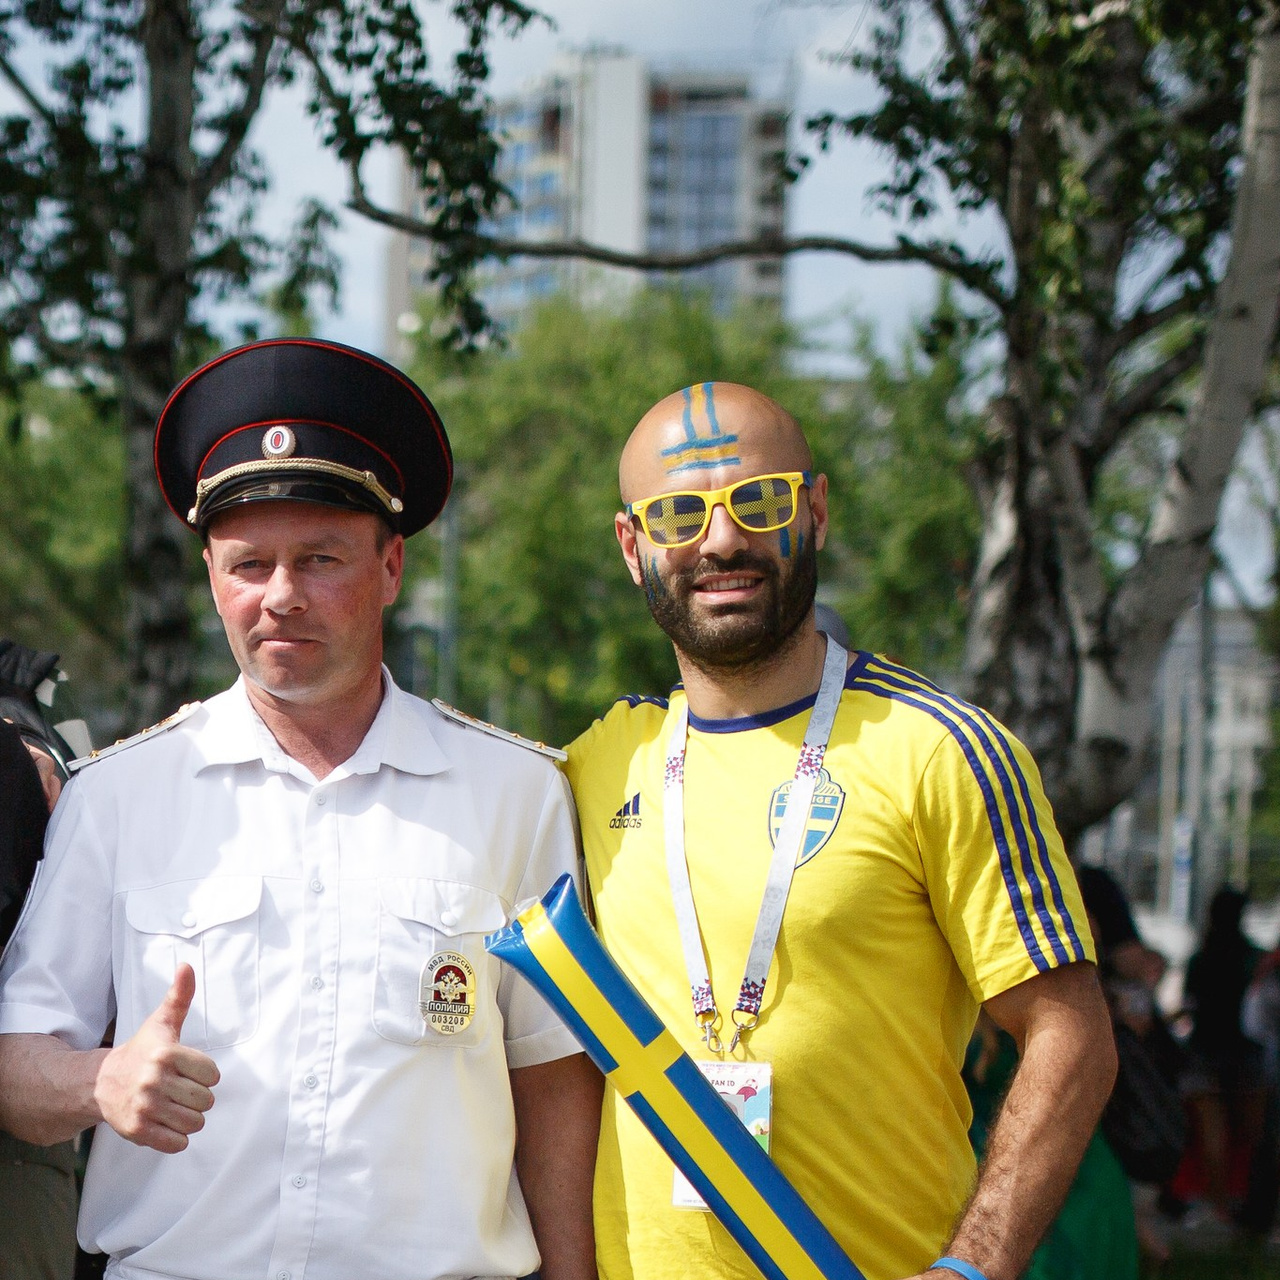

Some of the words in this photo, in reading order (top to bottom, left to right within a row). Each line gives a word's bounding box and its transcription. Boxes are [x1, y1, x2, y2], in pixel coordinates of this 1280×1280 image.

[609, 815, 642, 829] adidas
[428, 956, 444, 972] МВД
[447, 954, 473, 976] РОССИИ
[429, 1002, 469, 1014] ПОЛИЦИЯ
[431, 1014, 465, 1026] 003208
